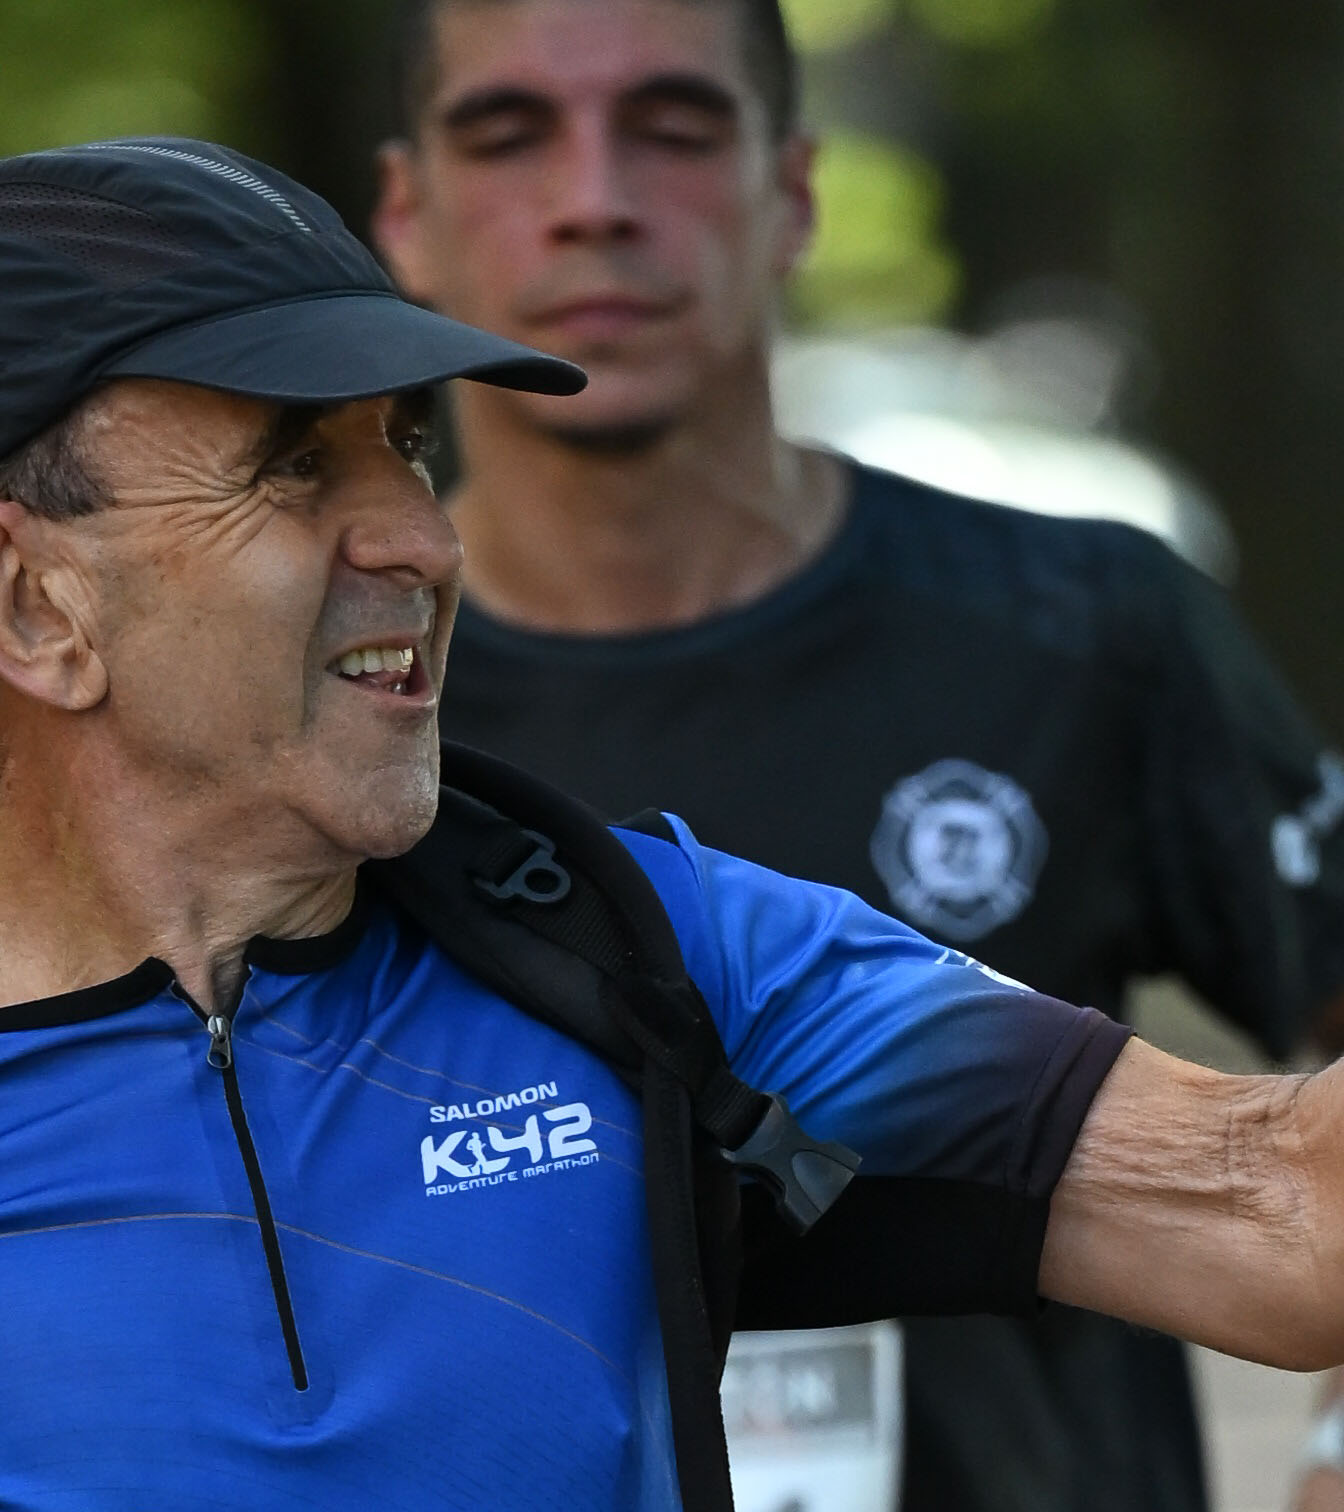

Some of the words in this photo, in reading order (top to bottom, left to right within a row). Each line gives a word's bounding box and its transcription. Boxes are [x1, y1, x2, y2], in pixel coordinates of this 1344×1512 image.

[430, 1081, 558, 1123] SALOMON
[420, 1102, 597, 1185] K42
[426, 1171, 518, 1197] ADVENTURE
[522, 1152, 599, 1178] MARATHON
